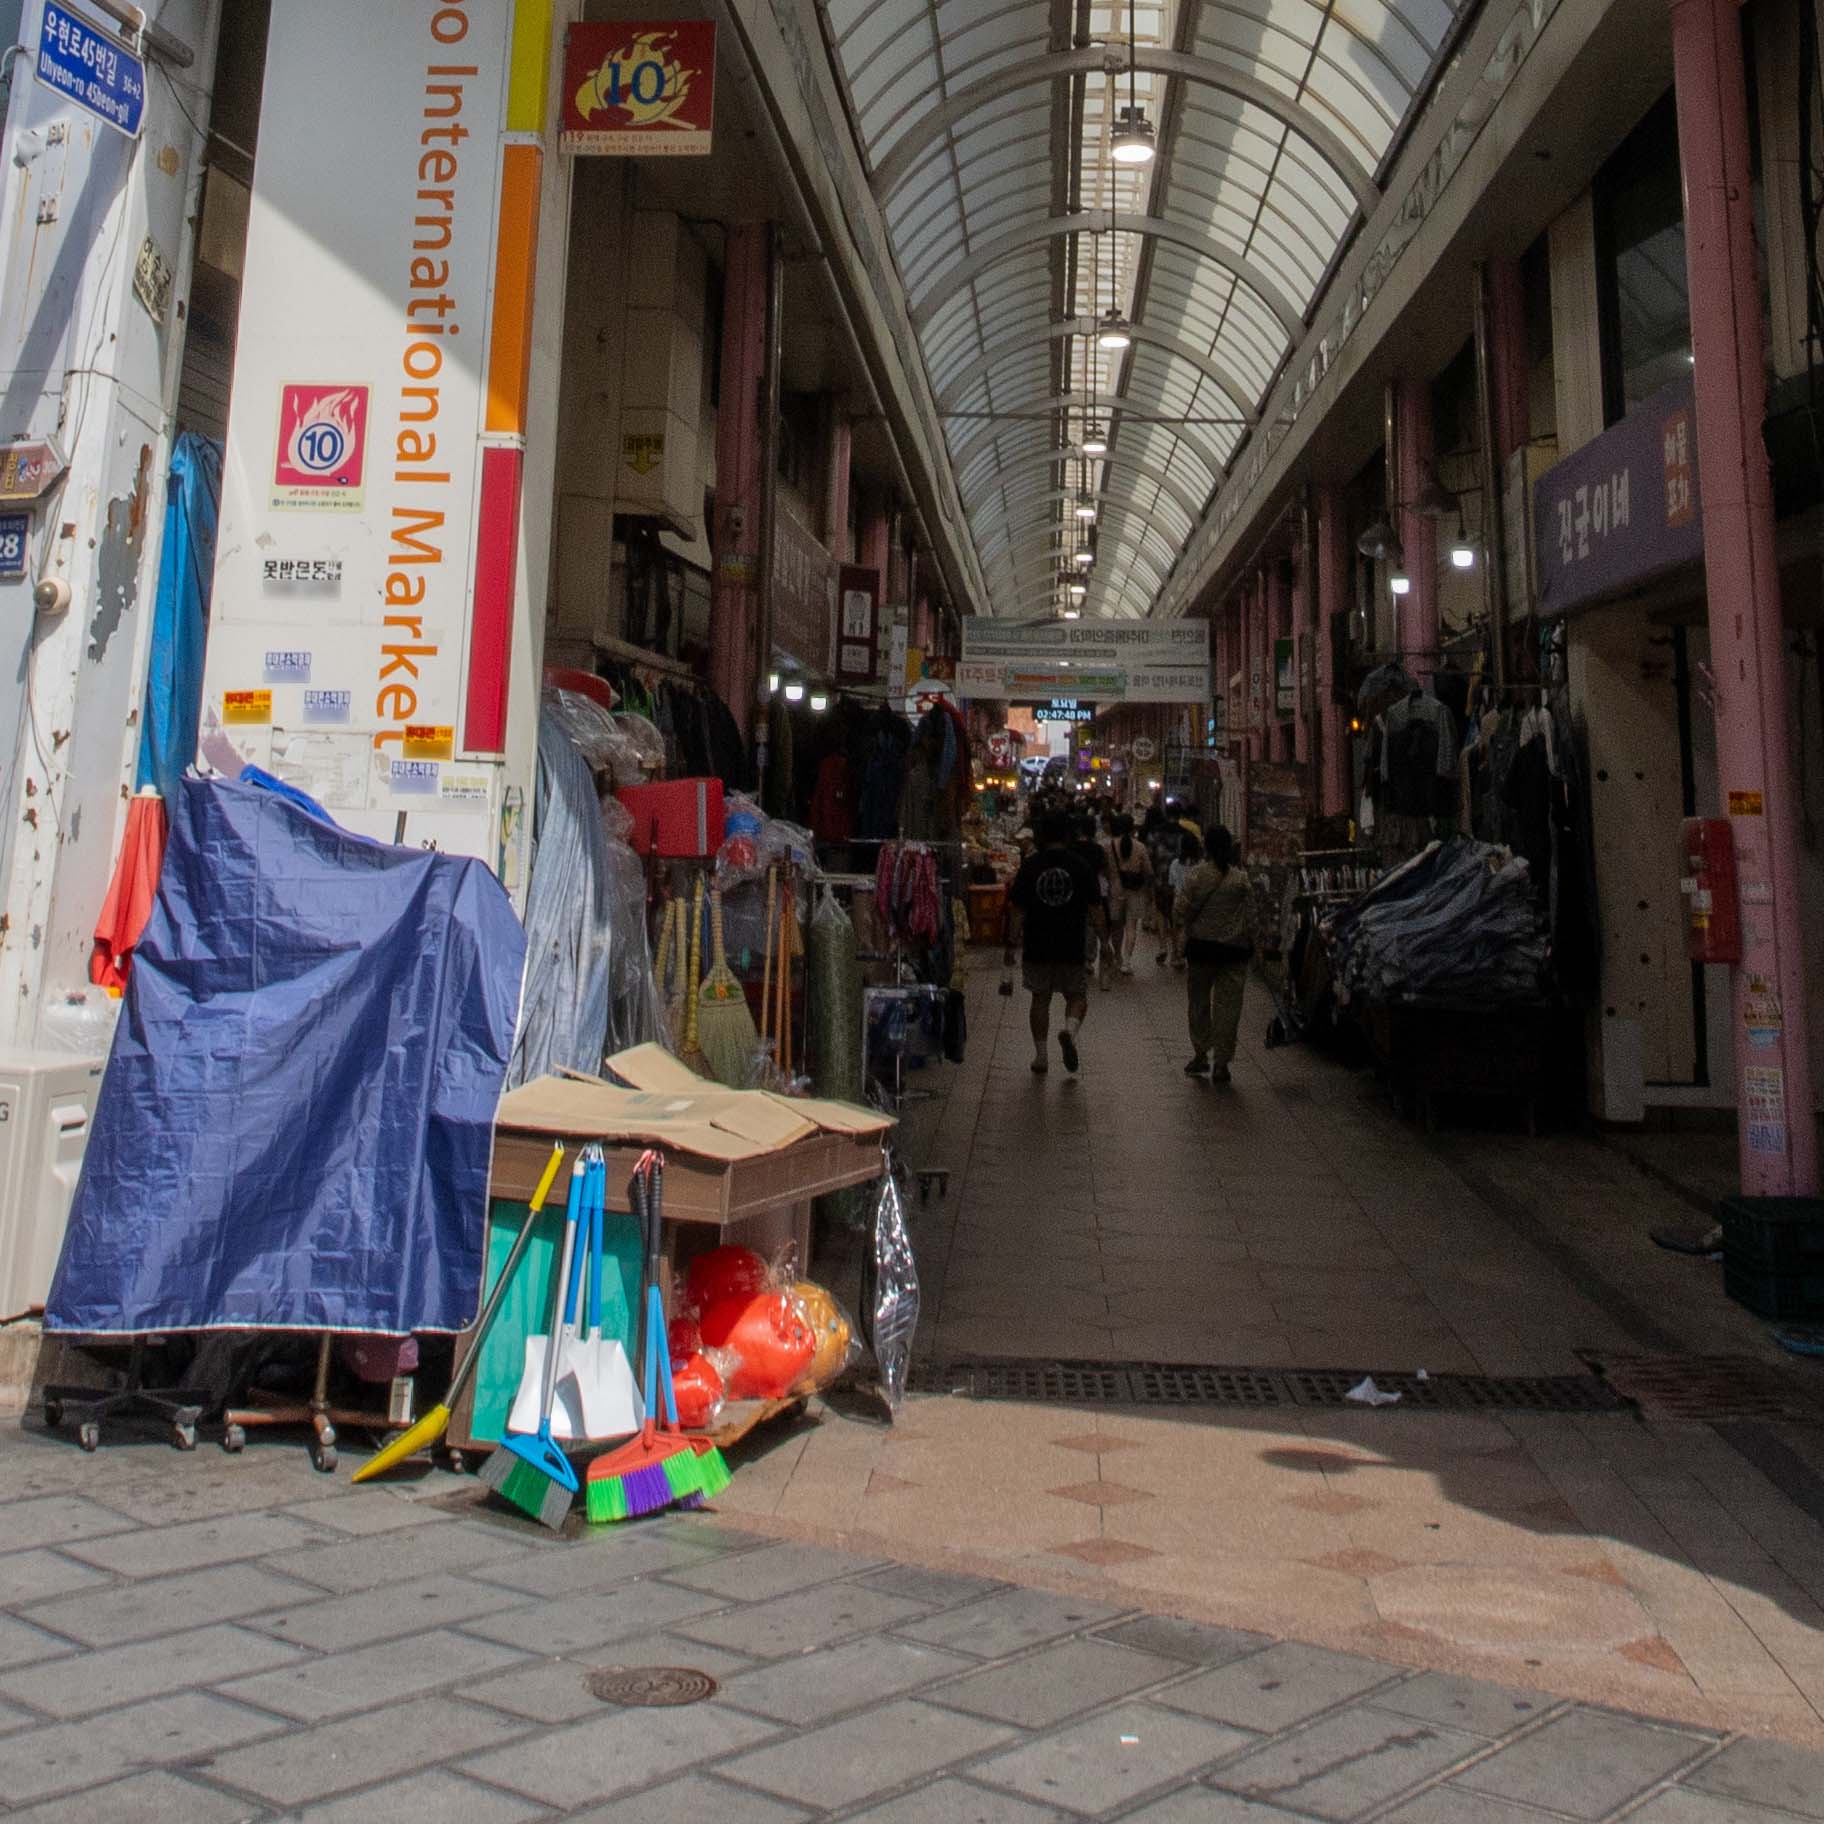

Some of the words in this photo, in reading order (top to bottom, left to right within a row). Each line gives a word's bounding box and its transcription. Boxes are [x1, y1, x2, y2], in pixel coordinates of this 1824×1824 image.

[45, 11, 118, 87] 우현로45번길
[608, 61, 666, 105] 10
[40, 50, 85, 96] Uhyeon-ro
[86, 81, 129, 124] 45beon-gil
[393, 63, 479, 484] International
[305, 430, 339, 463] 10
[374, 510, 447, 750] Market
[1077, 710, 1091, 720] PM
